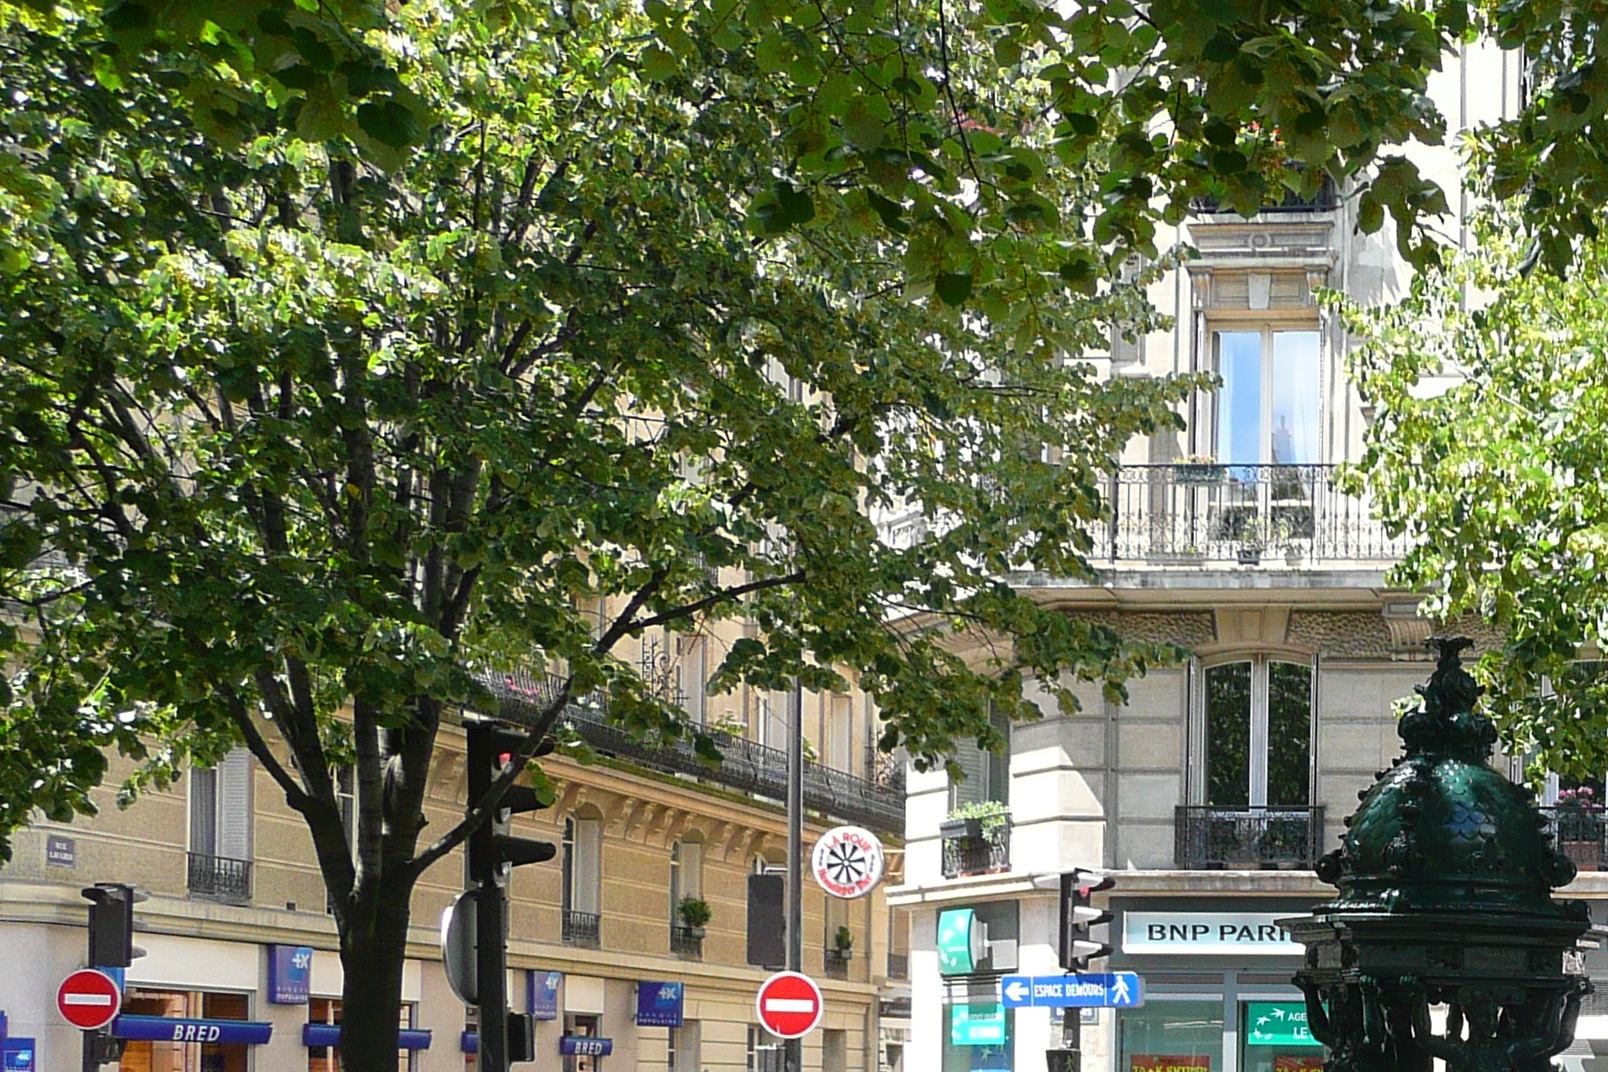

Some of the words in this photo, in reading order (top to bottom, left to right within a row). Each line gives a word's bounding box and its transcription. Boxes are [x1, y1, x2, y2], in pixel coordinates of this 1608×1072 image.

[824, 836, 840, 850] LA
[843, 832, 873, 853] ROUE
[1148, 924, 1210, 941] BNP
[1034, 984, 1063, 998] ESPACE
[1066, 982, 1104, 997] DEMOURS
[173, 1024, 221, 1041] BRED
[574, 1041, 603, 1055] BRED
